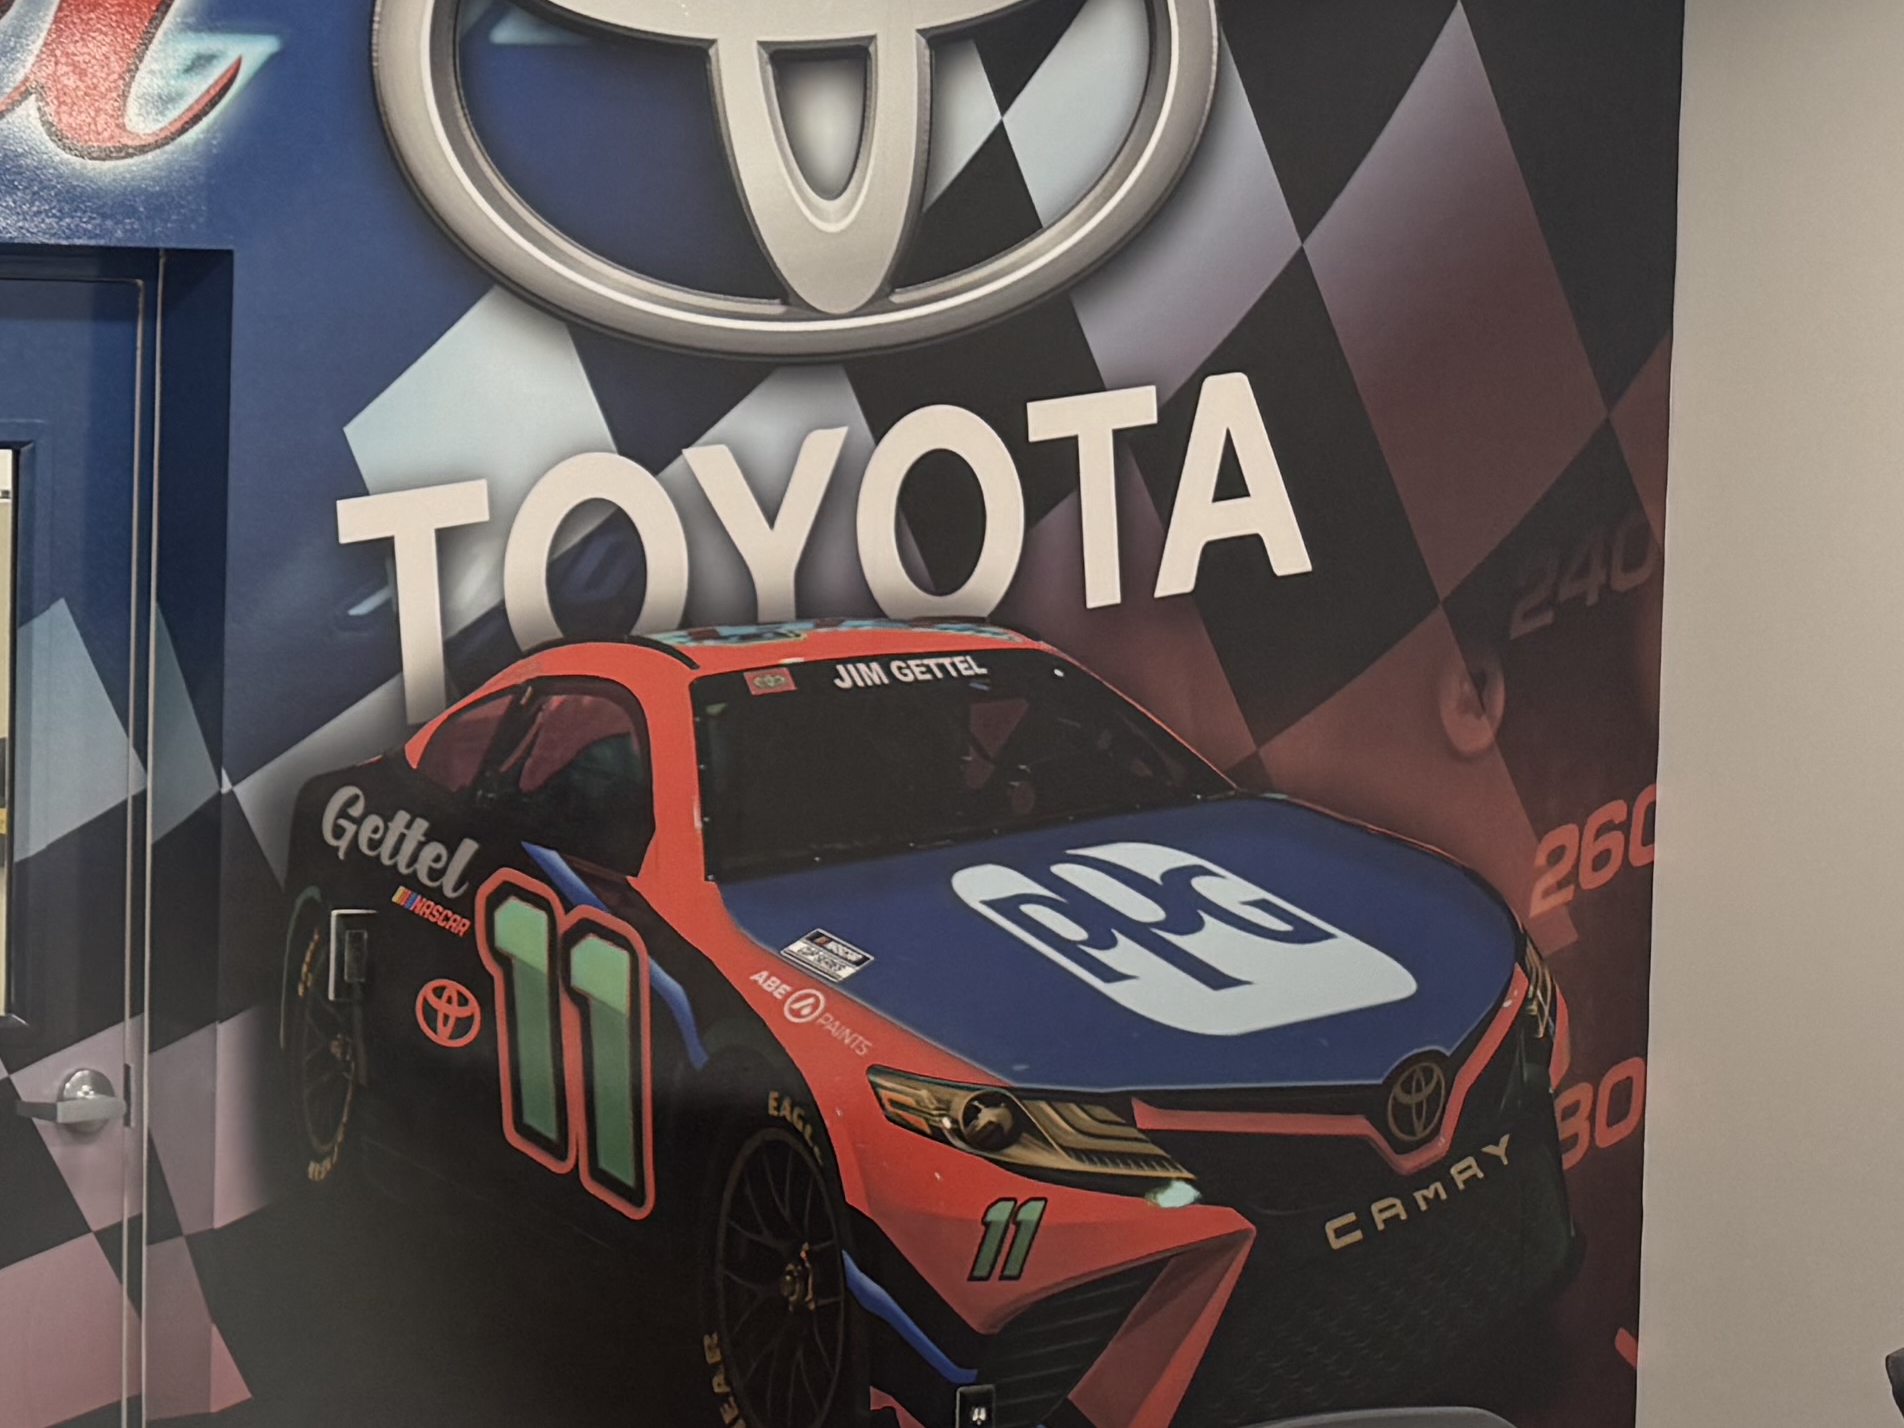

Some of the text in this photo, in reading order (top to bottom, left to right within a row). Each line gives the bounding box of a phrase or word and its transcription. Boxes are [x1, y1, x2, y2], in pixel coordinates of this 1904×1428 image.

[335, 372, 1313, 726] TOYOTA
[833, 655, 988, 689] JIM GETTEL
[322, 785, 479, 898] Gettel
[409, 898, 472, 938] NASCAR
[485, 885, 645, 1206] 11
[749, 970, 873, 1056] ABE PAINTS
[966, 1196, 1047, 1281] 11
